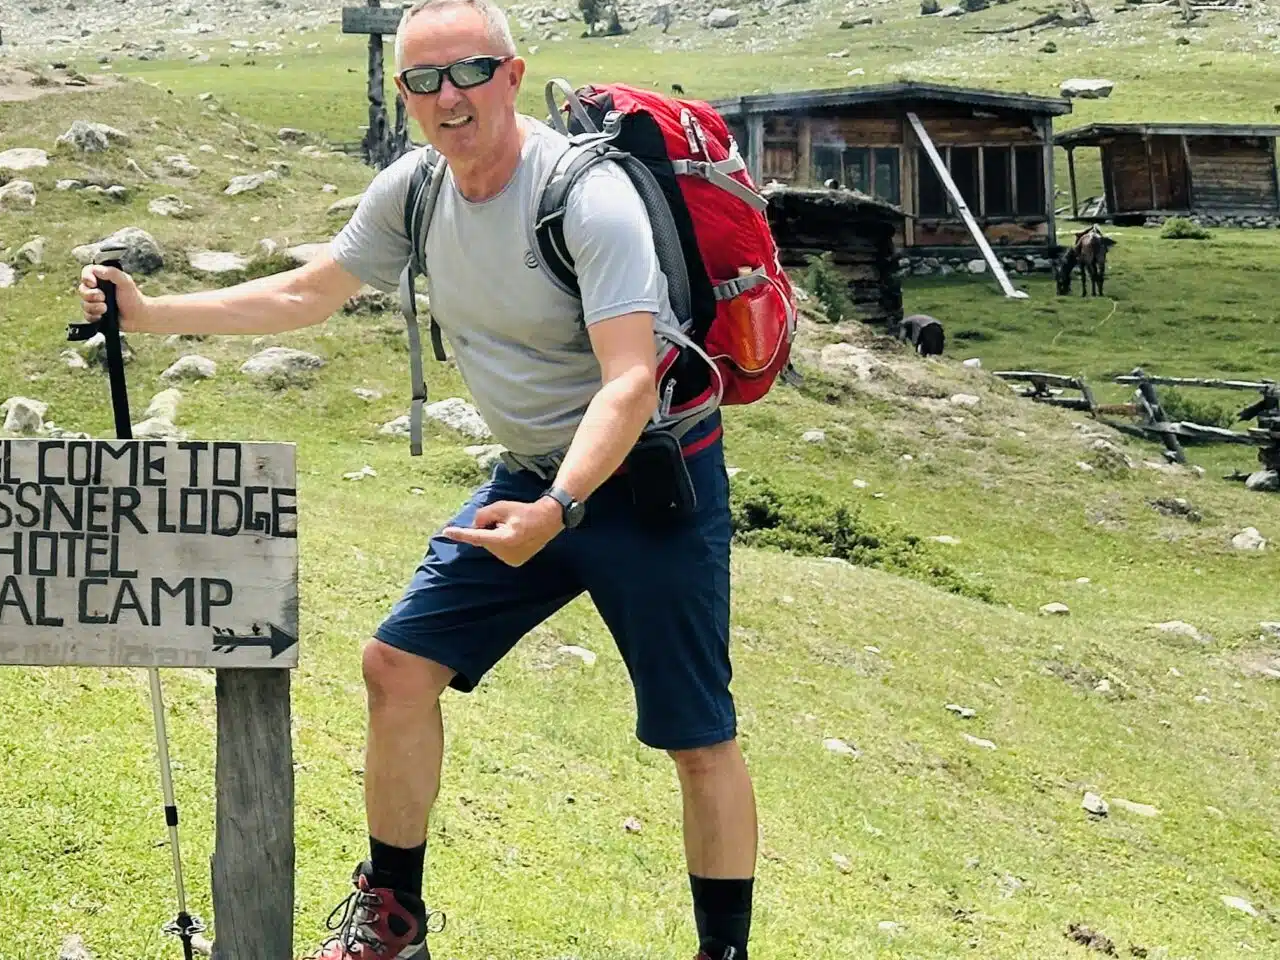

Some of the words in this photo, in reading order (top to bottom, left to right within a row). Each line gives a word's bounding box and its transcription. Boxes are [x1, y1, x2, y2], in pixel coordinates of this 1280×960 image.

[178, 441, 242, 487] TO
[157, 486, 297, 538] LODGE
[78, 577, 234, 627] CAMP
